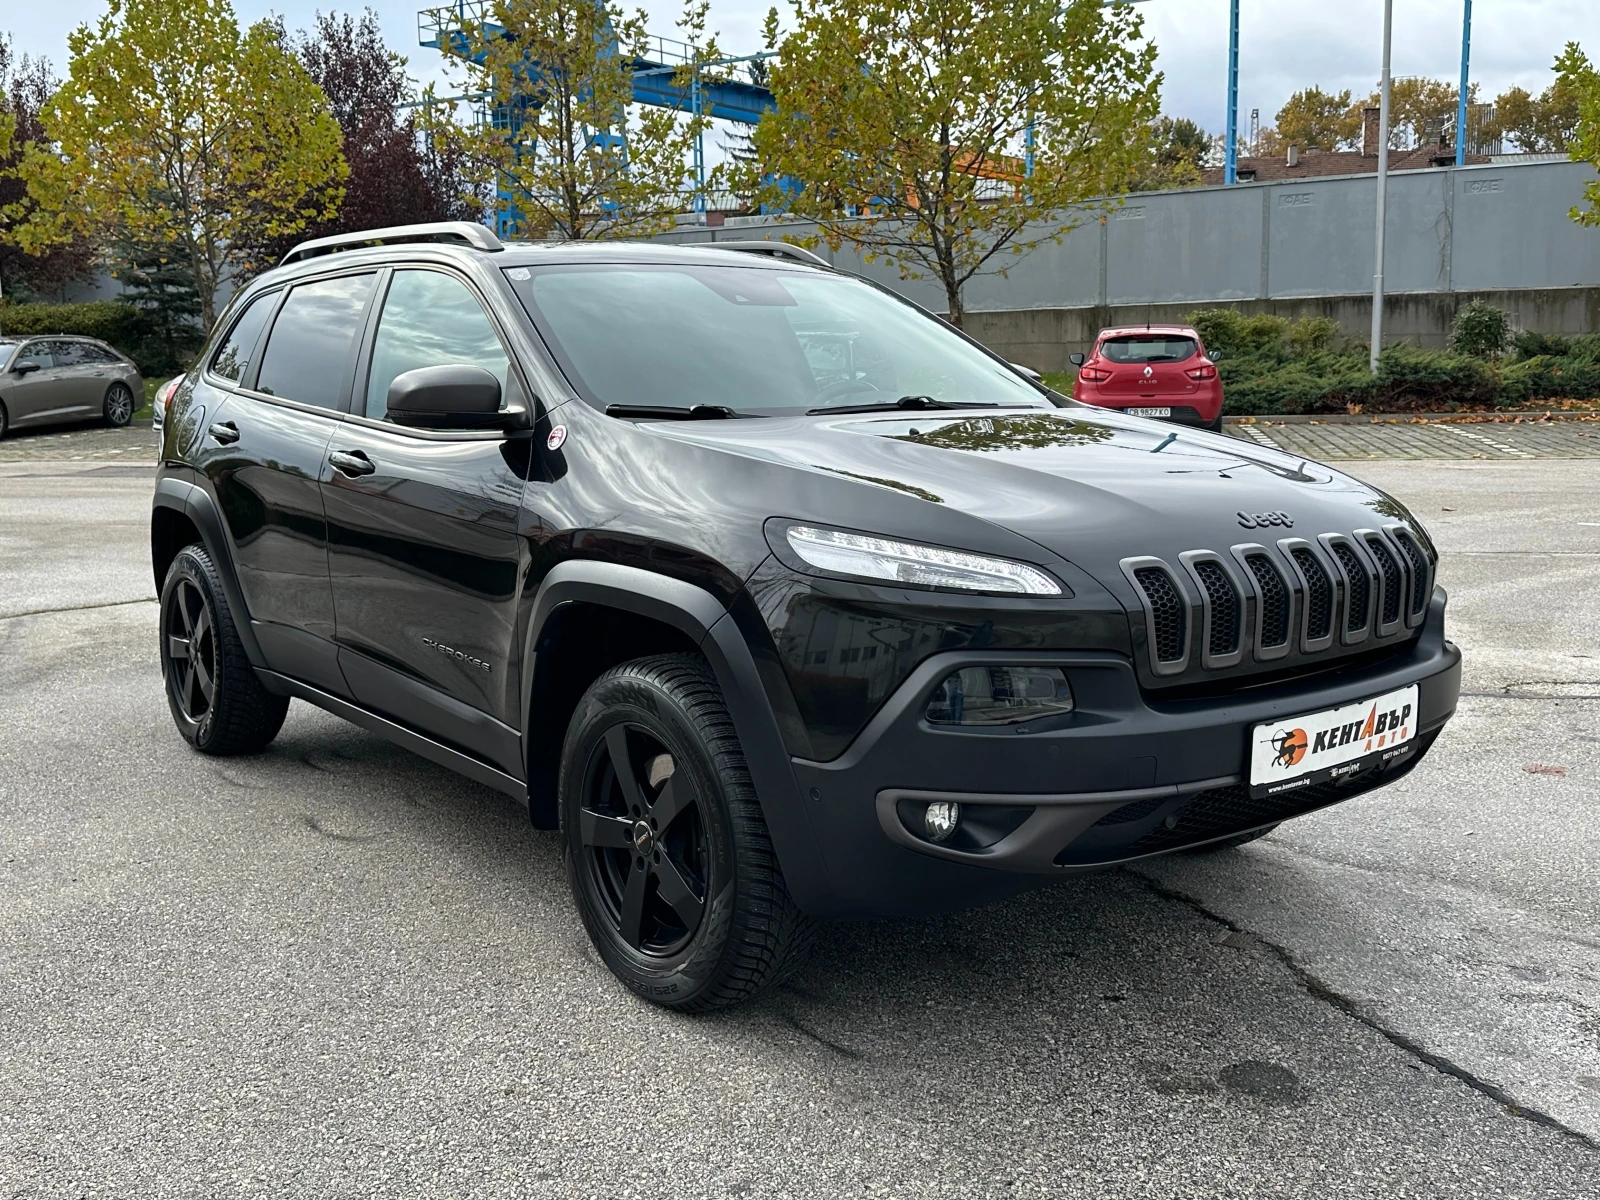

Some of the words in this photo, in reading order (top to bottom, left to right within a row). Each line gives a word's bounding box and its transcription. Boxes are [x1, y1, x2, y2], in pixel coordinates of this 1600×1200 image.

[1159, 408, 1169, 416] KO
[1236, 510, 1295, 530] Jeep
[422, 637, 491, 672] CHEROKEE
[1312, 702, 1411, 754] КЕНТАВЪР
[1364, 727, 1408, 752] АВТО
